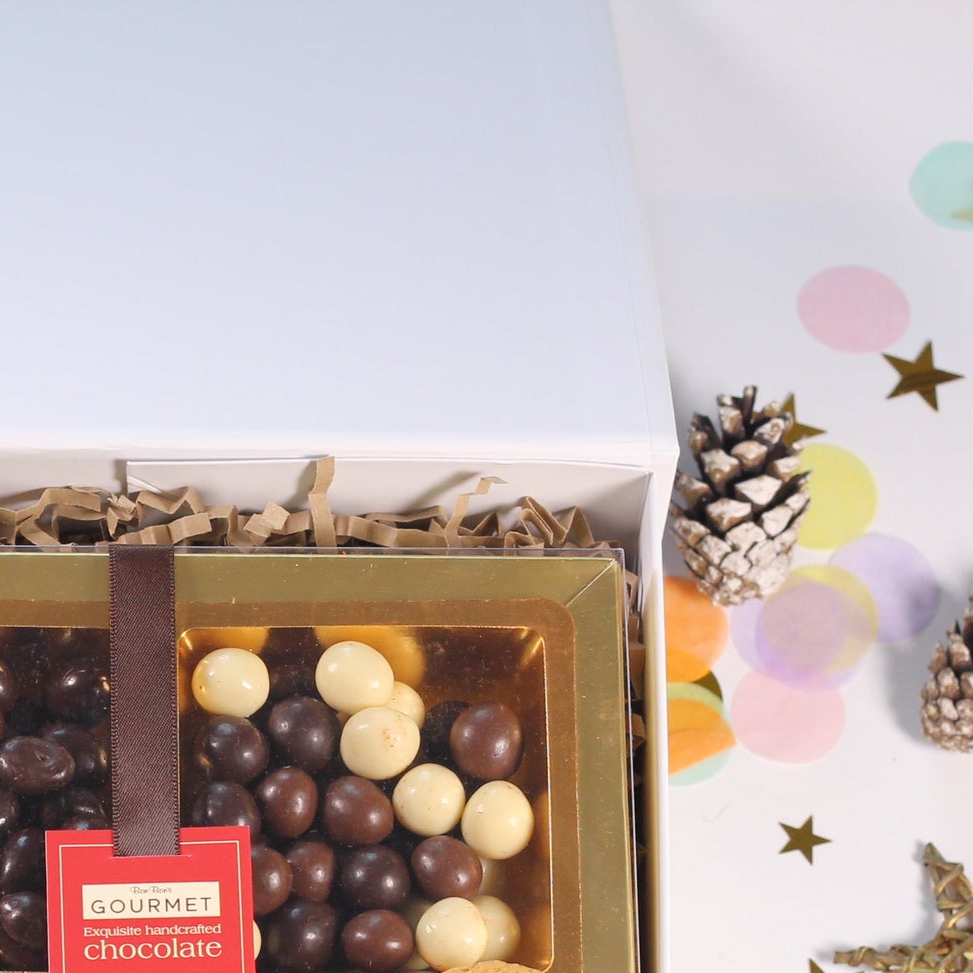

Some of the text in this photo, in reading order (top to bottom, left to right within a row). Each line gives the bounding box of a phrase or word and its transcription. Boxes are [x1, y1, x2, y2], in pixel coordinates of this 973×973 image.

[90, 897, 212, 914] GOURMET
[83, 924, 222, 939] Exquisite handcrafted
[84, 938, 222, 960] chocolate
